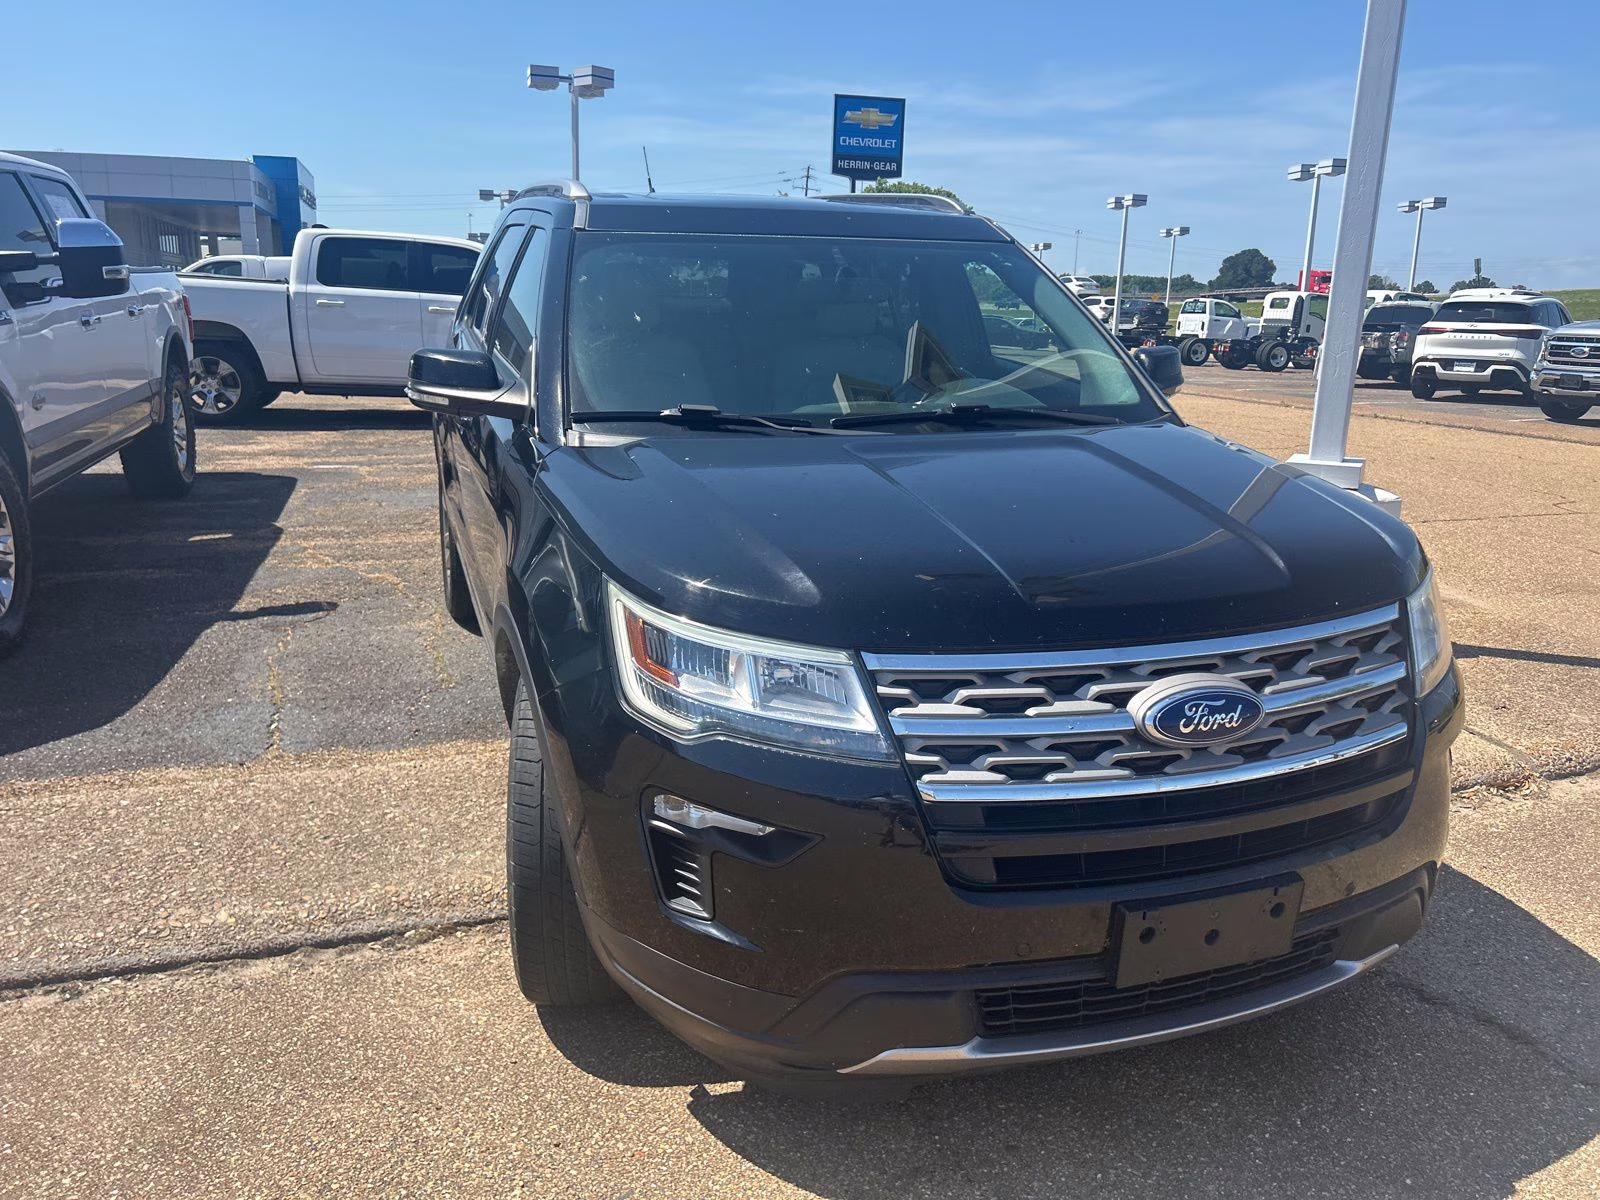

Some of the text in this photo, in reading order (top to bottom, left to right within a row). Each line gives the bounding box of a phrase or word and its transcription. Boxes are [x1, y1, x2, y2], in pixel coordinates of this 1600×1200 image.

[839, 136, 897, 149] CHEVROLET
[837, 159, 897, 171] HERRIN-GEAR
[1179, 699, 1243, 734] Ford
